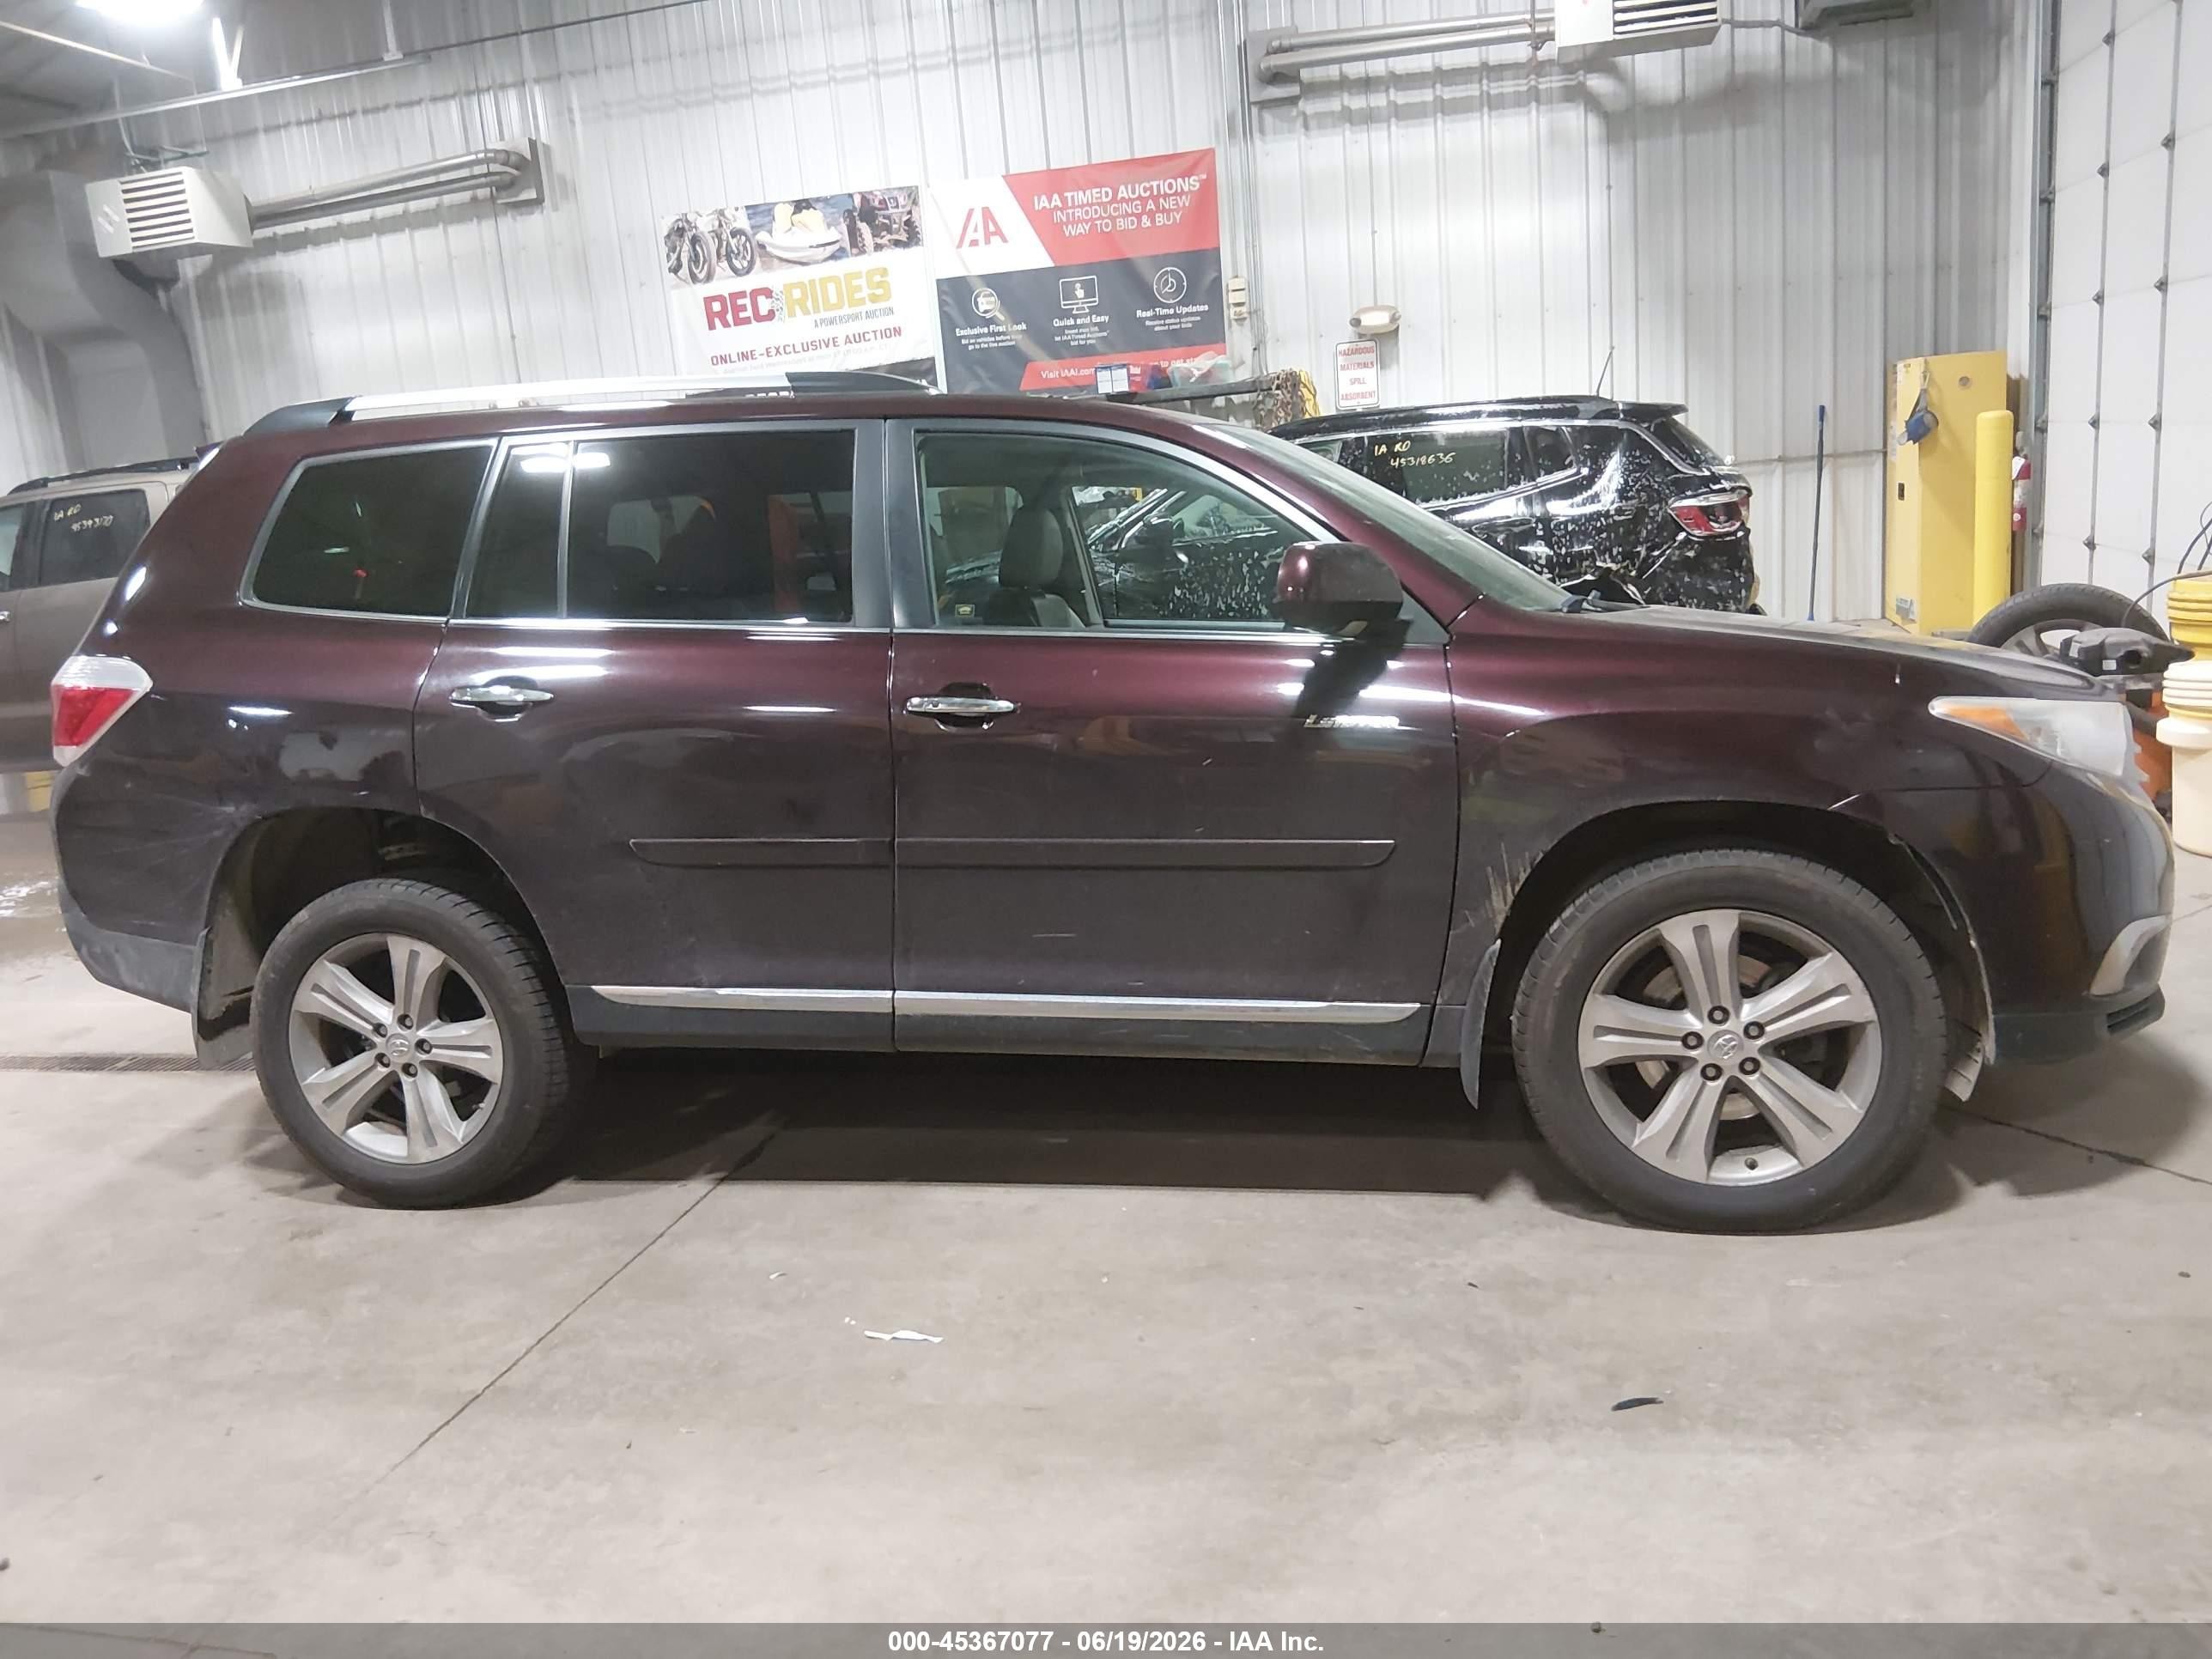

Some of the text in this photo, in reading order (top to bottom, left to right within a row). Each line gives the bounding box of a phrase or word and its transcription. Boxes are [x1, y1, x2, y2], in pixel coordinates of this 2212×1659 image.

[1034, 196, 1061, 210] IAA
[1064, 186, 1113, 206] TIMED
[1053, 195, 1191, 223] INTRODUCING A NEW
[1063, 211, 1182, 237] WAY TO BID & BUY
[703, 267, 892, 331] REC RIDES
[819, 311, 864, 328] POWERSPORT
[865, 306, 895, 323] AUCTION
[1136, 304, 1209, 318] Real-Time Updates
[1054, 314, 1109, 327] Quick and Easy
[956, 322, 1027, 337] Exclusive First Look
[710, 336, 840, 367] ONLINE-EXCLUSIVE
[844, 325, 902, 346] AUCTION
[1338, 345, 1375, 357] HAZARDOUS
[1340, 361, 1375, 371] MATERIALS
[1041, 370, 1060, 379] Visit
[1349, 377, 1367, 386] SPILL
[1340, 390, 1376, 400] ABSORBENT
[1390, 452, 1456, 469] 45318636
